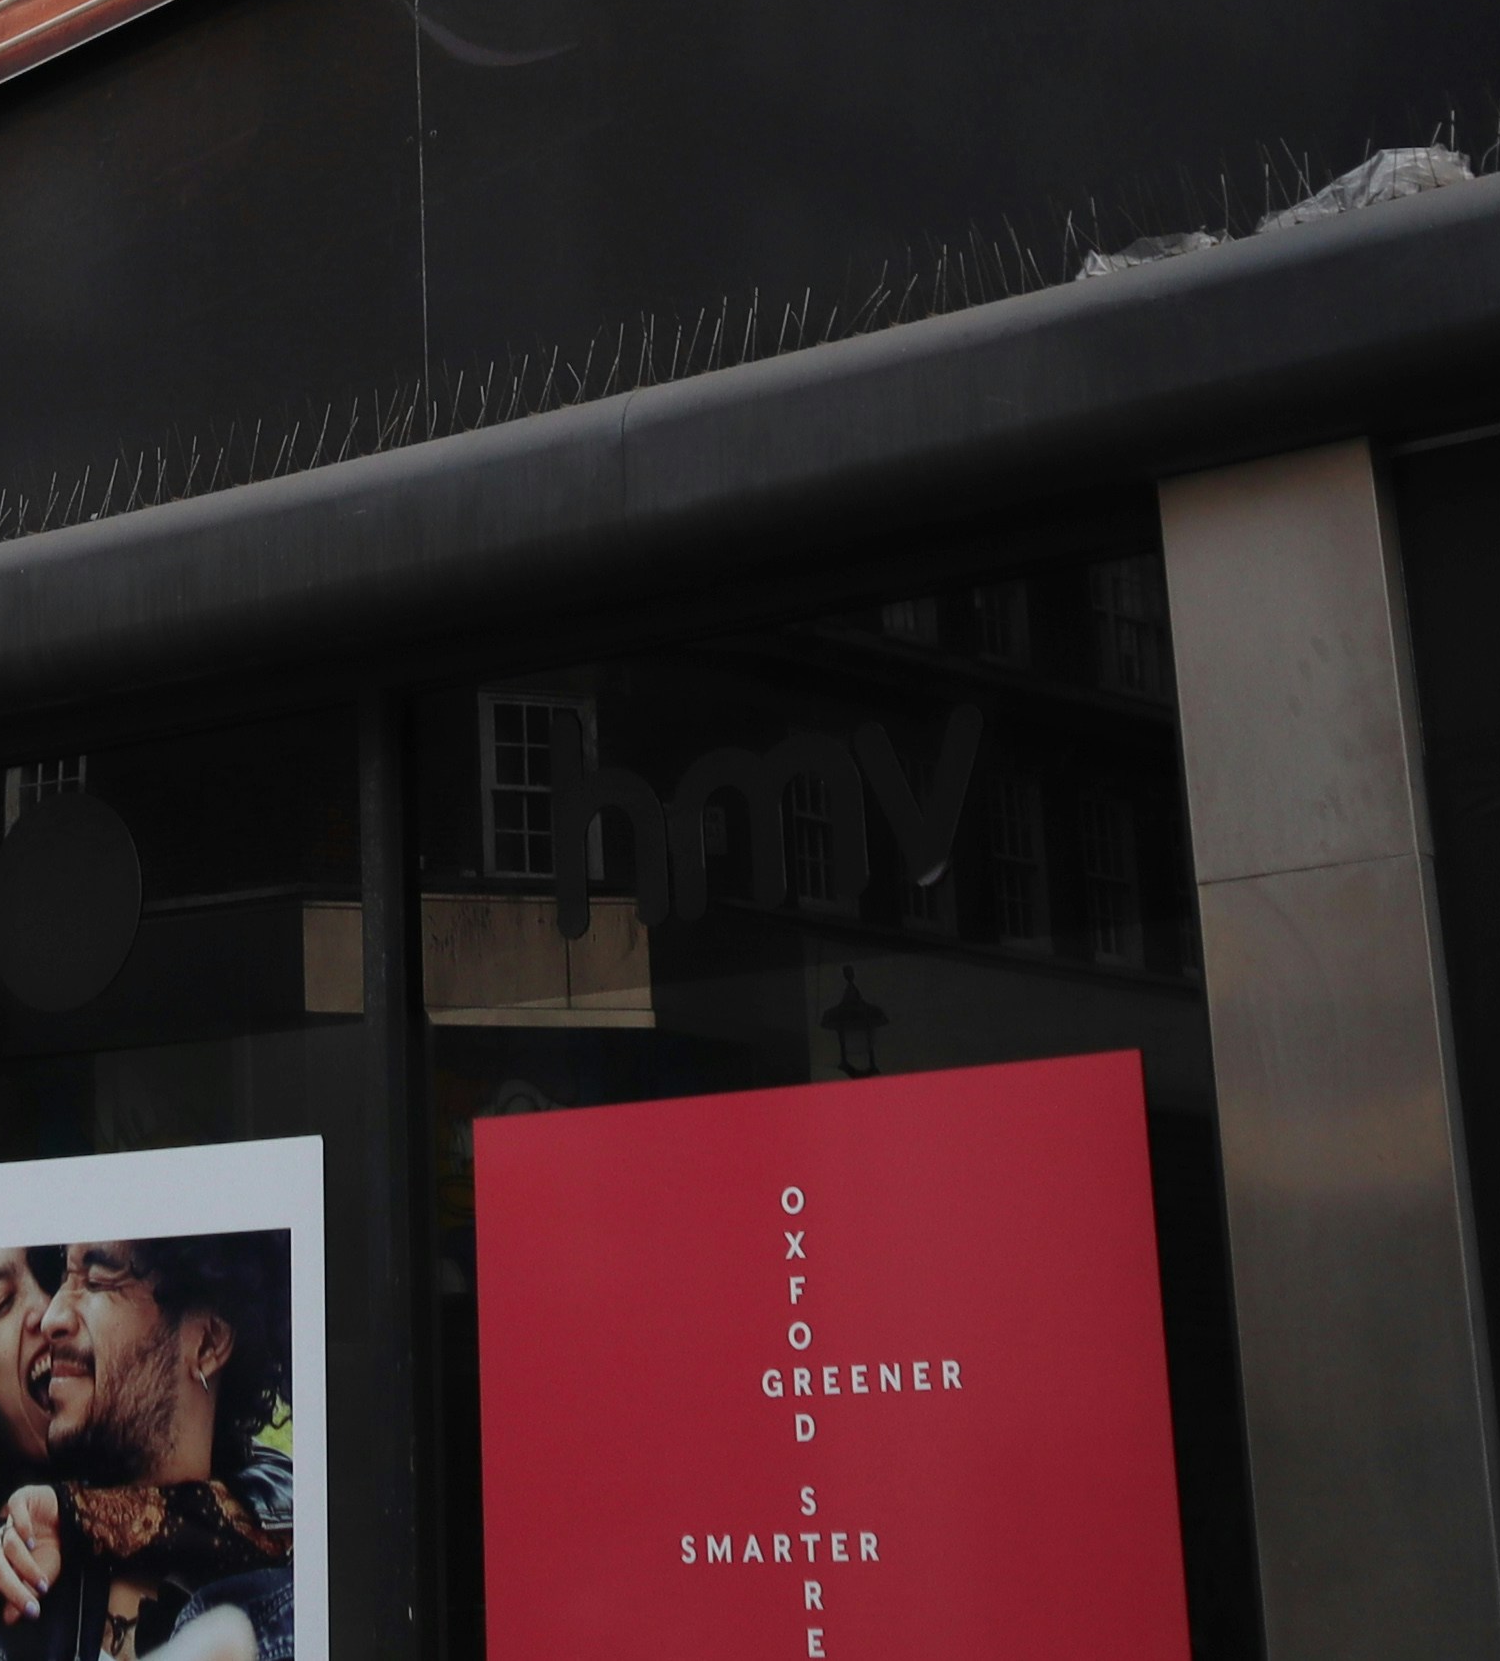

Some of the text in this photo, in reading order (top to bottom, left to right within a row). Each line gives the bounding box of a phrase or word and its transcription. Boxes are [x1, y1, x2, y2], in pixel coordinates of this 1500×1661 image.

[551, 703, 985, 940] hmv
[762, 1359, 963, 1398] GREENER
[681, 1531, 880, 1564] SMARTER
